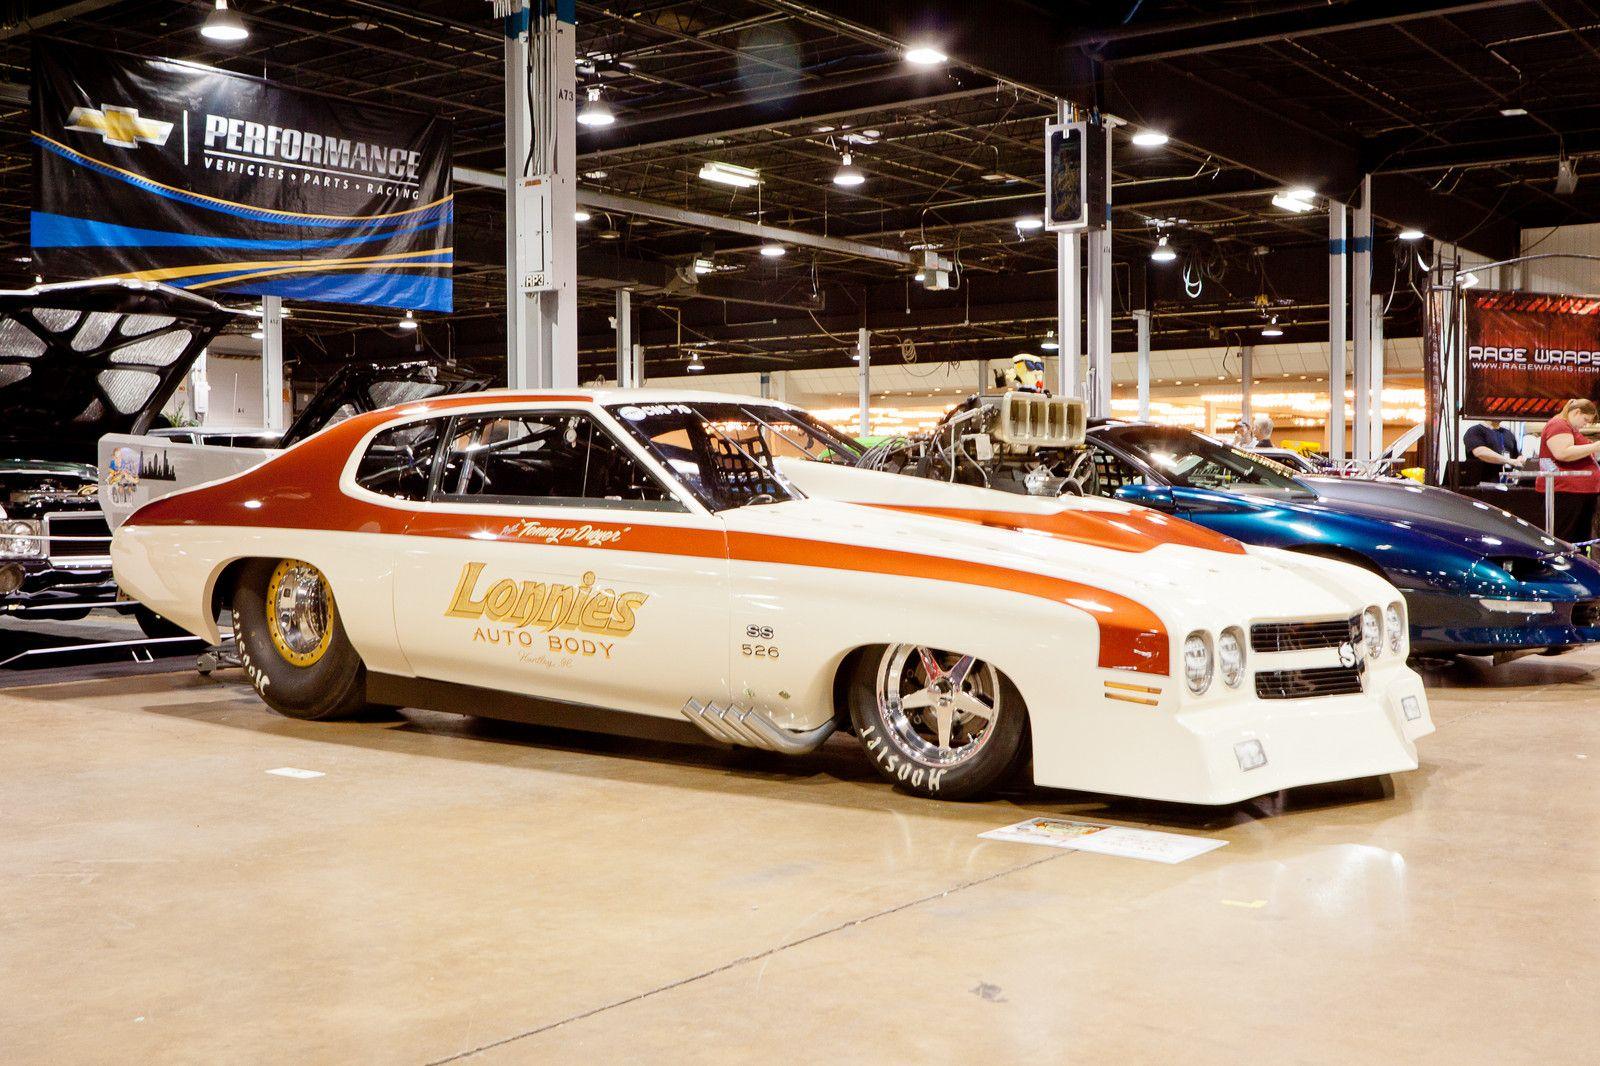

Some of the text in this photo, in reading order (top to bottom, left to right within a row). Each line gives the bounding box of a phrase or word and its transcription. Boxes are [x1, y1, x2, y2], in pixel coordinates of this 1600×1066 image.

[204, 114, 421, 180] PERFORMANCE
[204, 157, 420, 200] VEHICLES PARTS RACING
[1469, 346, 1600, 366] RAGE WRAPS
[444, 562, 649, 638] Lonnies
[472, 627, 615, 659] AUTO BODY
[746, 624, 774, 640] SS
[741, 643, 780, 660] 526
